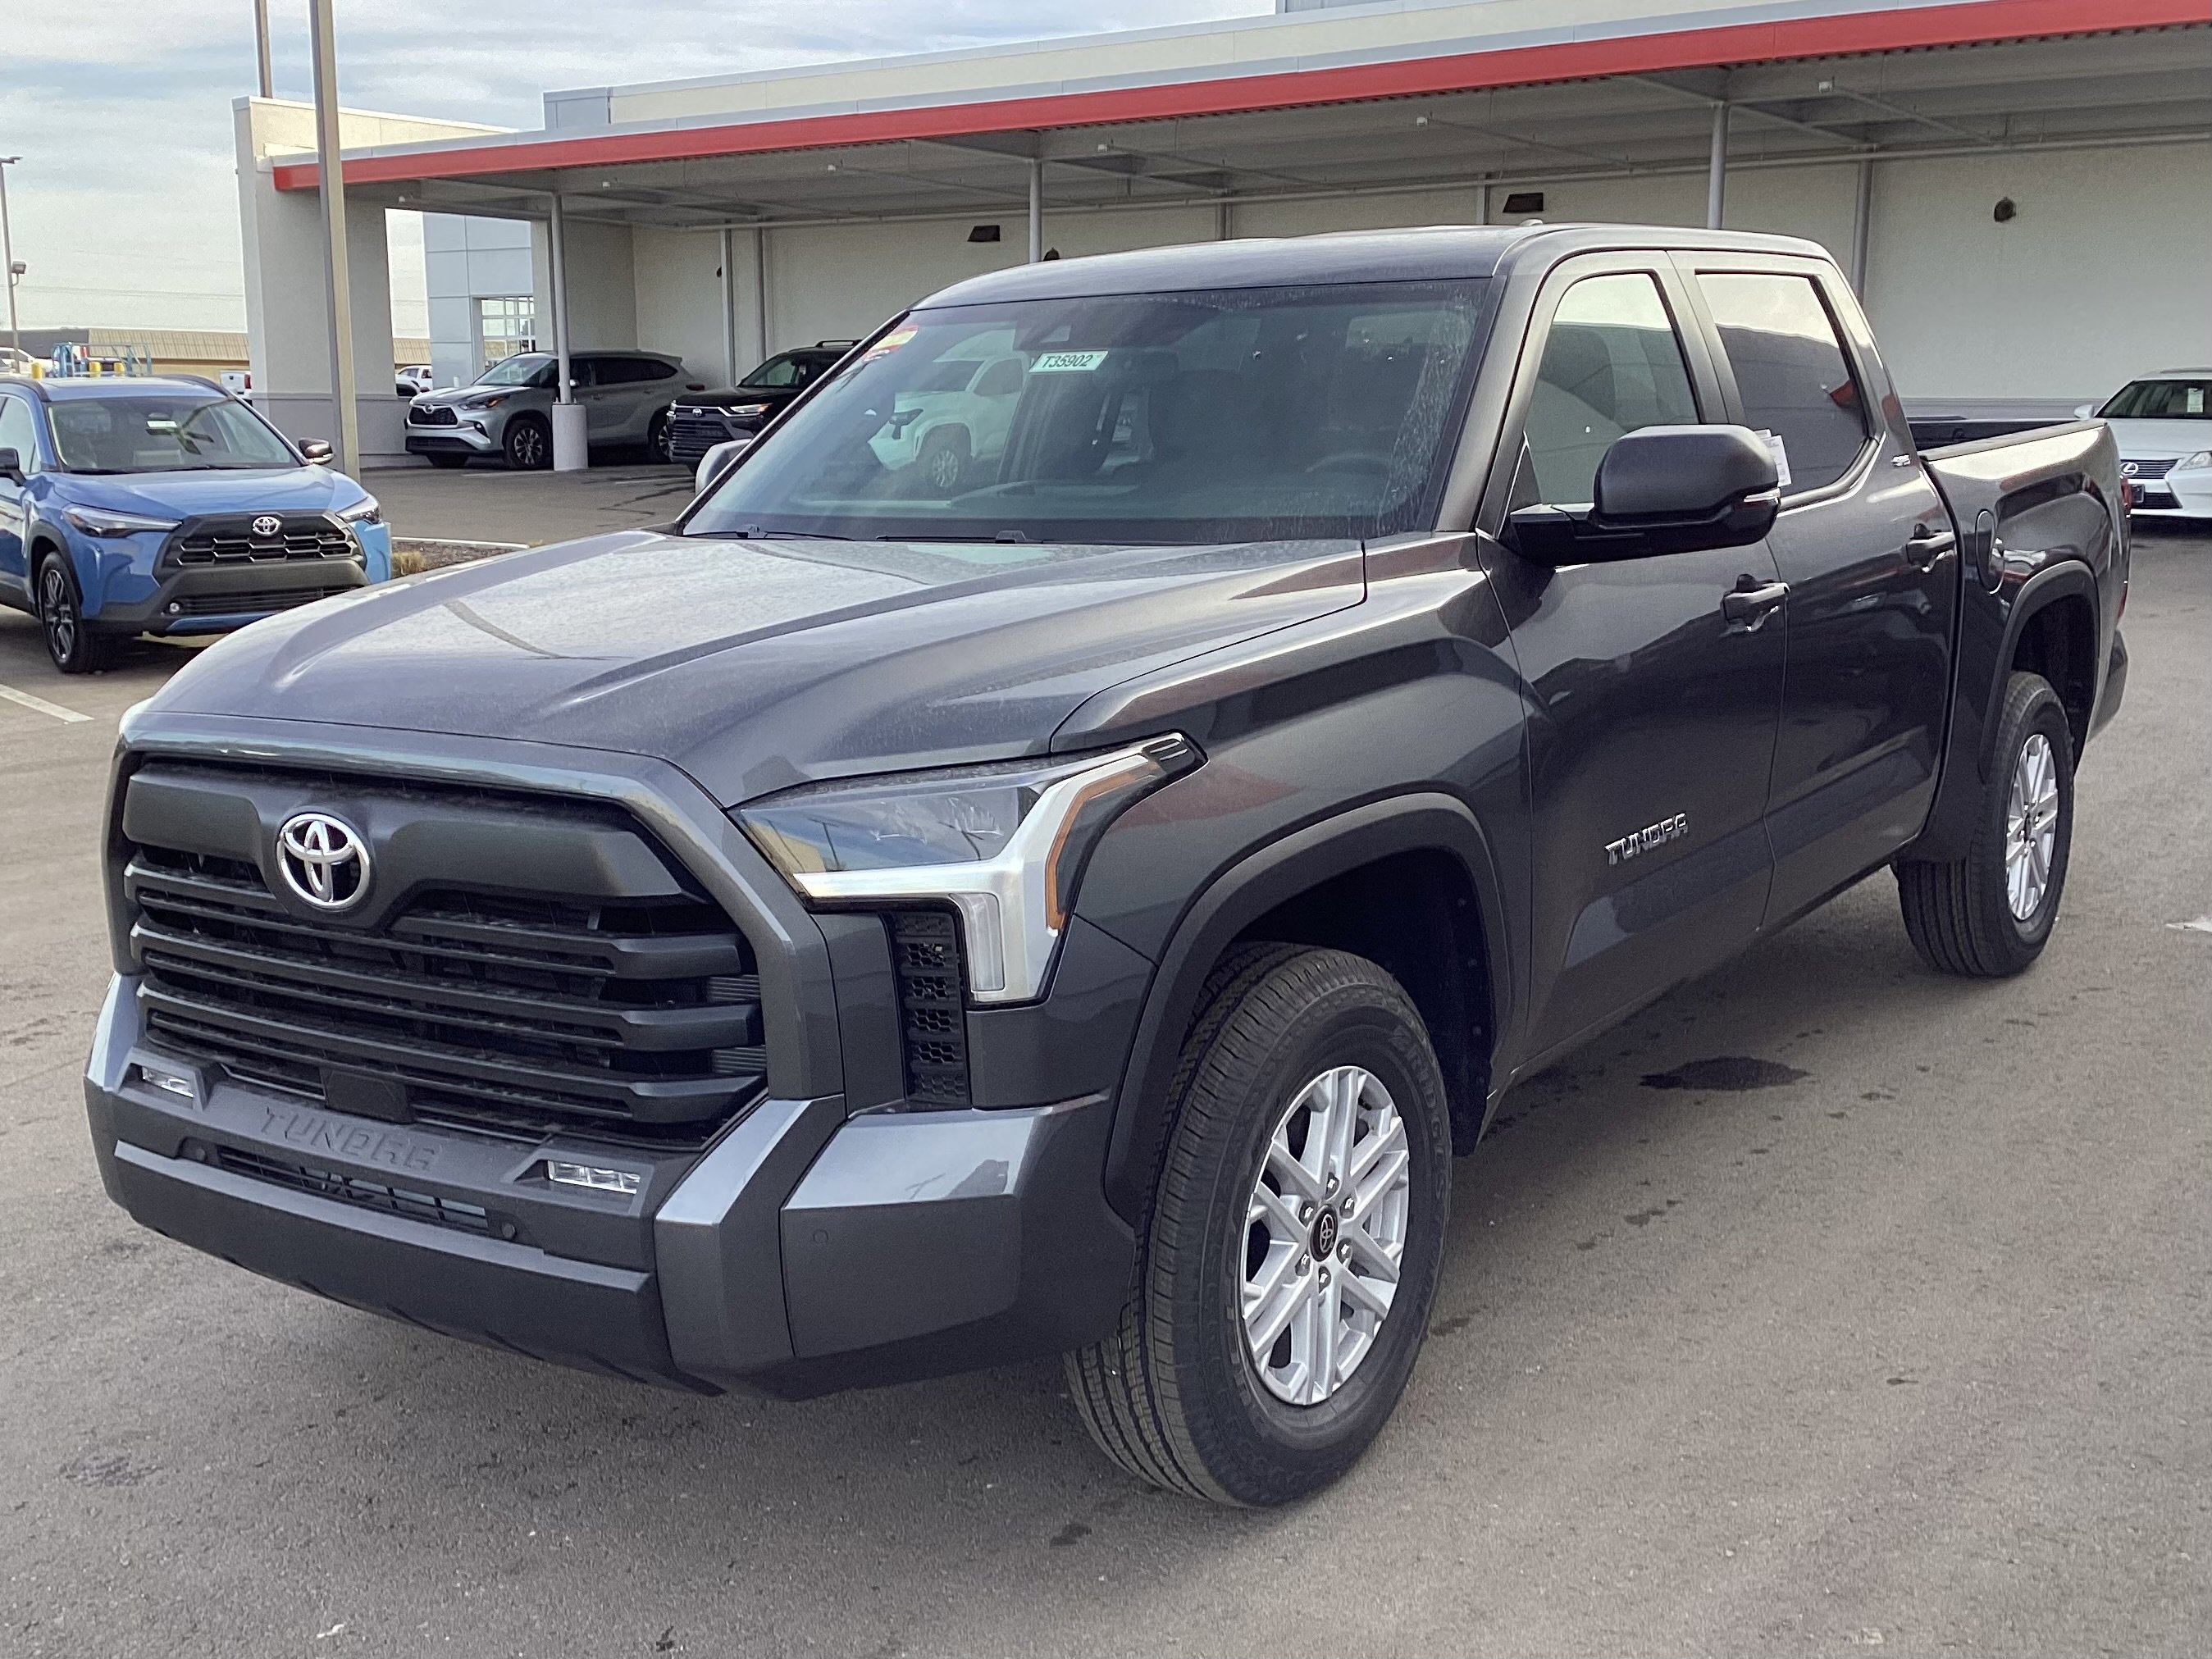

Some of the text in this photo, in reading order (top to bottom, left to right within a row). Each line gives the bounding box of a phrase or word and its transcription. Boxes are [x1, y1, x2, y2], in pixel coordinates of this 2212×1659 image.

[1042, 354, 1093, 368] T35902
[1605, 813, 1689, 865] TUNDRA
[261, 1106, 443, 1170] TUNDRA
